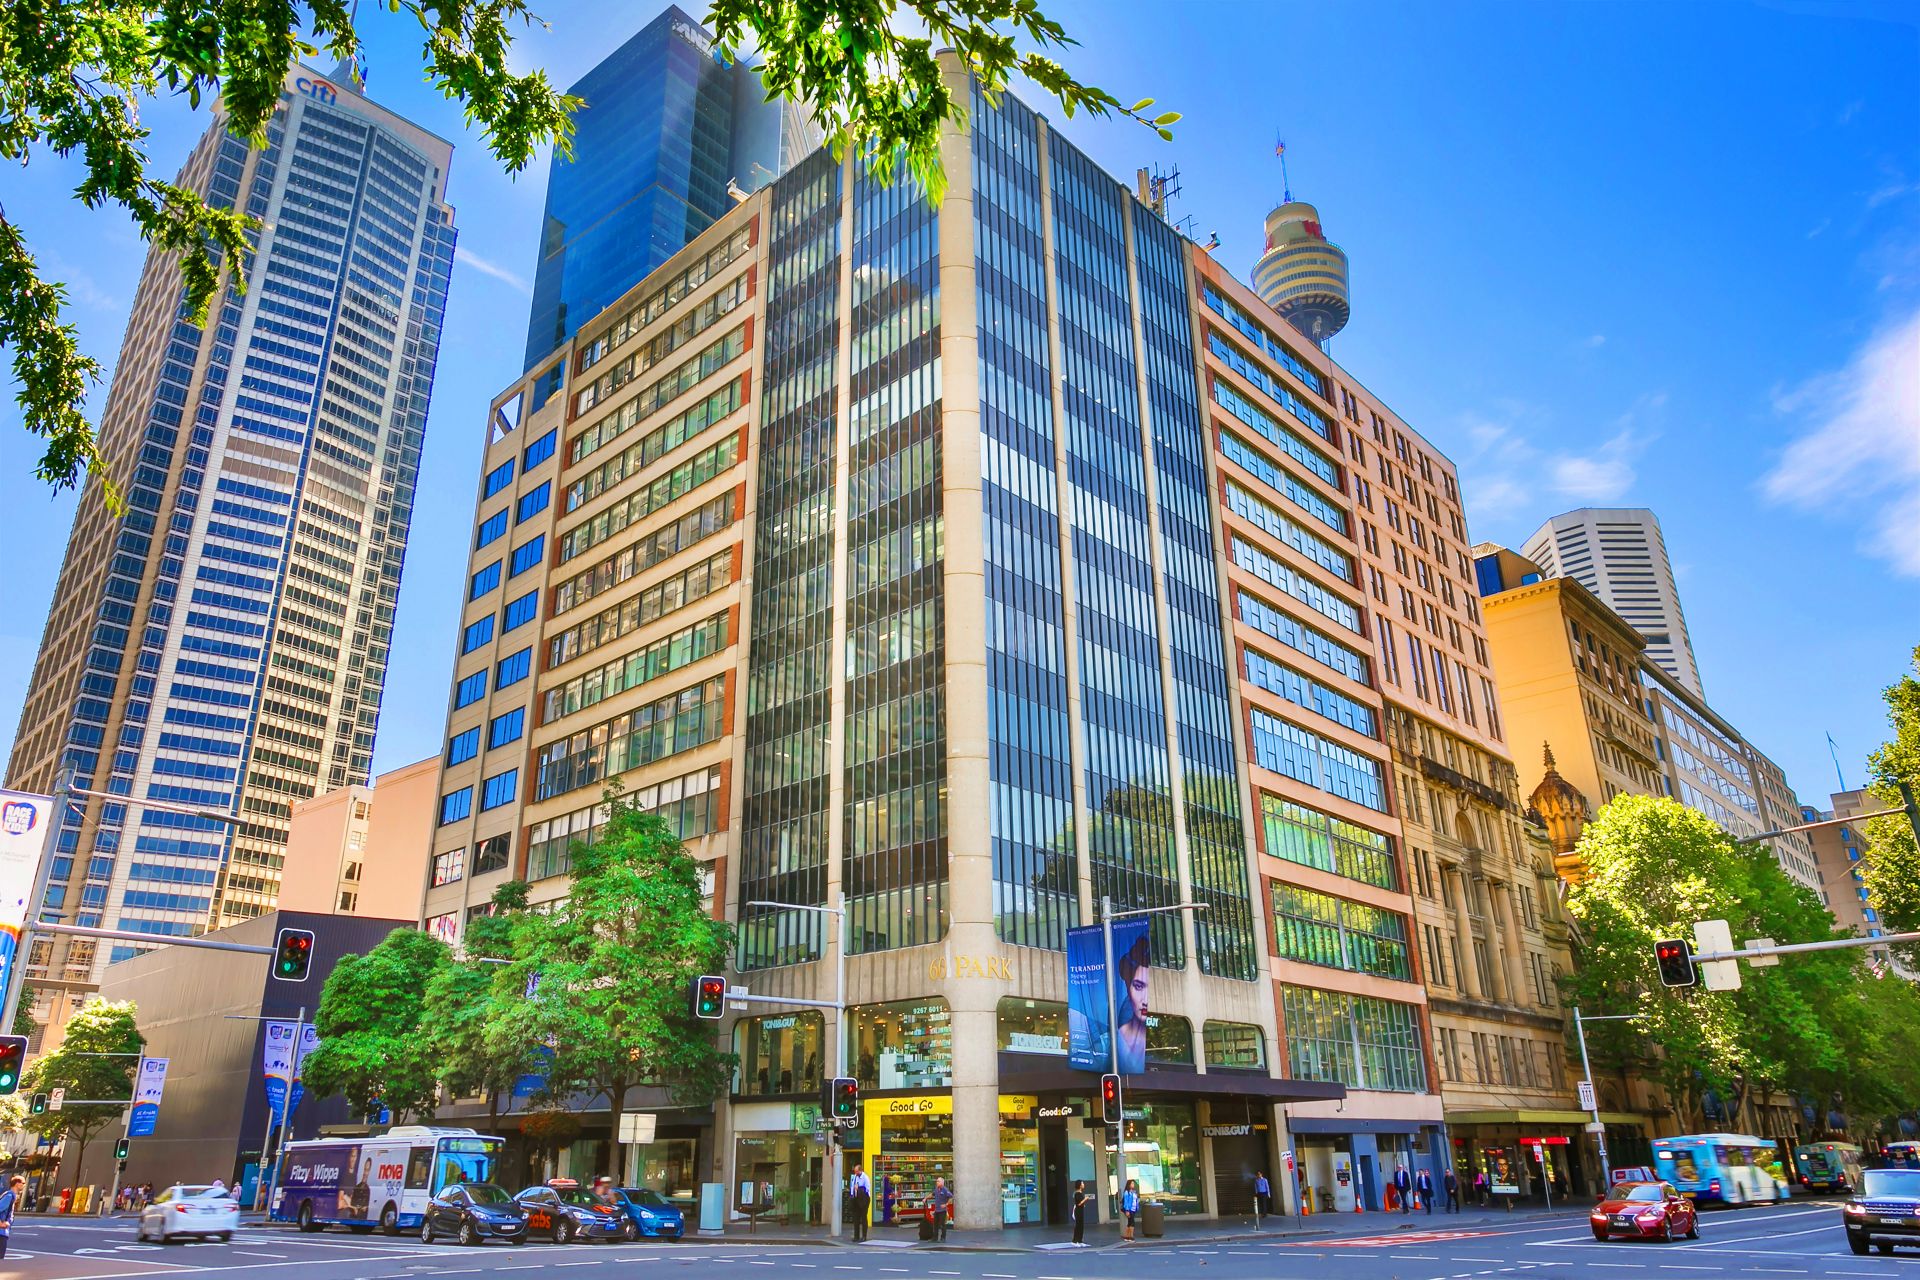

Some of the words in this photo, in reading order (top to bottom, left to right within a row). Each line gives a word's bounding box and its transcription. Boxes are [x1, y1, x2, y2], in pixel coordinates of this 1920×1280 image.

[928, 956, 947, 980] 60
[955, 954, 1015, 981] PARK
[1070, 964, 1105, 973] TURANDOT
[763, 1017, 796, 1030] TONI&GUY
[1010, 1032, 1063, 1050] TONI&GUY
[890, 1100, 914, 1112] Good
[919, 1099, 934, 1112] Go
[1203, 1125, 1250, 1136] TONI&GUY
[290, 1164, 309, 1182] Fitzy
[313, 1163, 339, 1182] Wippa
[378, 1163, 403, 1180] nova
